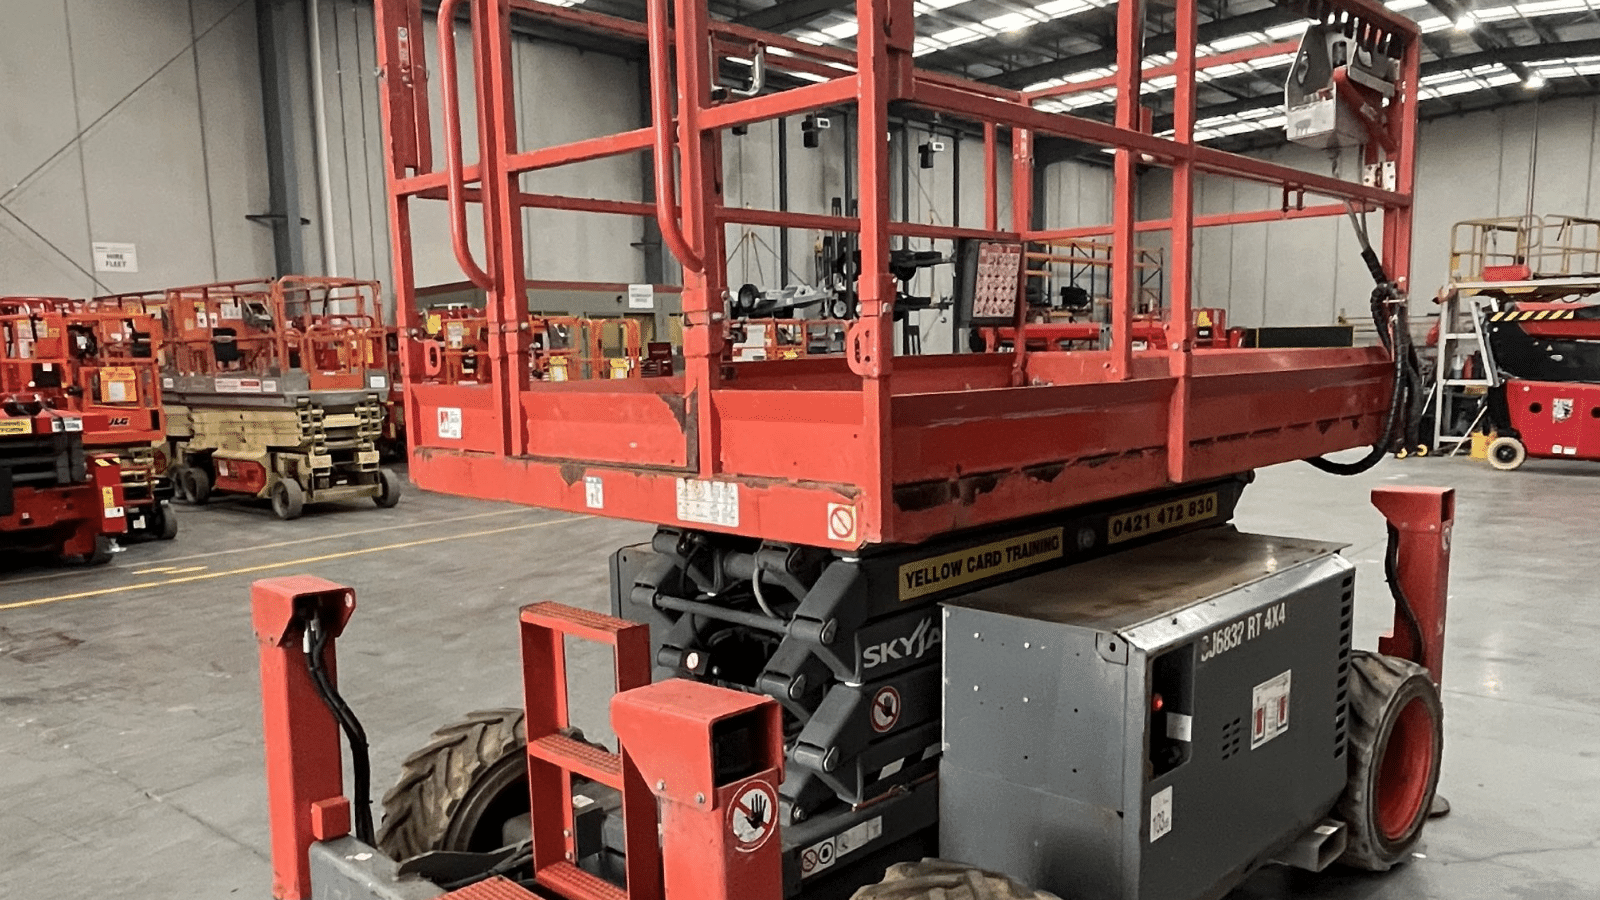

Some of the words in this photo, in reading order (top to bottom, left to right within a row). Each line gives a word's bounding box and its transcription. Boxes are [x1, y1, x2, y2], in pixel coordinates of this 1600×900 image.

[109, 417, 129, 426] JLG
[1112, 512, 1151, 537] 0421
[1157, 502, 1184, 525] 472
[1189, 496, 1214, 518] 830
[905, 557, 963, 589] YELLOW
[967, 551, 1002, 574] CARD
[1005, 533, 1060, 566] TRAINING
[1247, 612, 1263, 641] RT
[1264, 602, 1286, 631] 4X4
